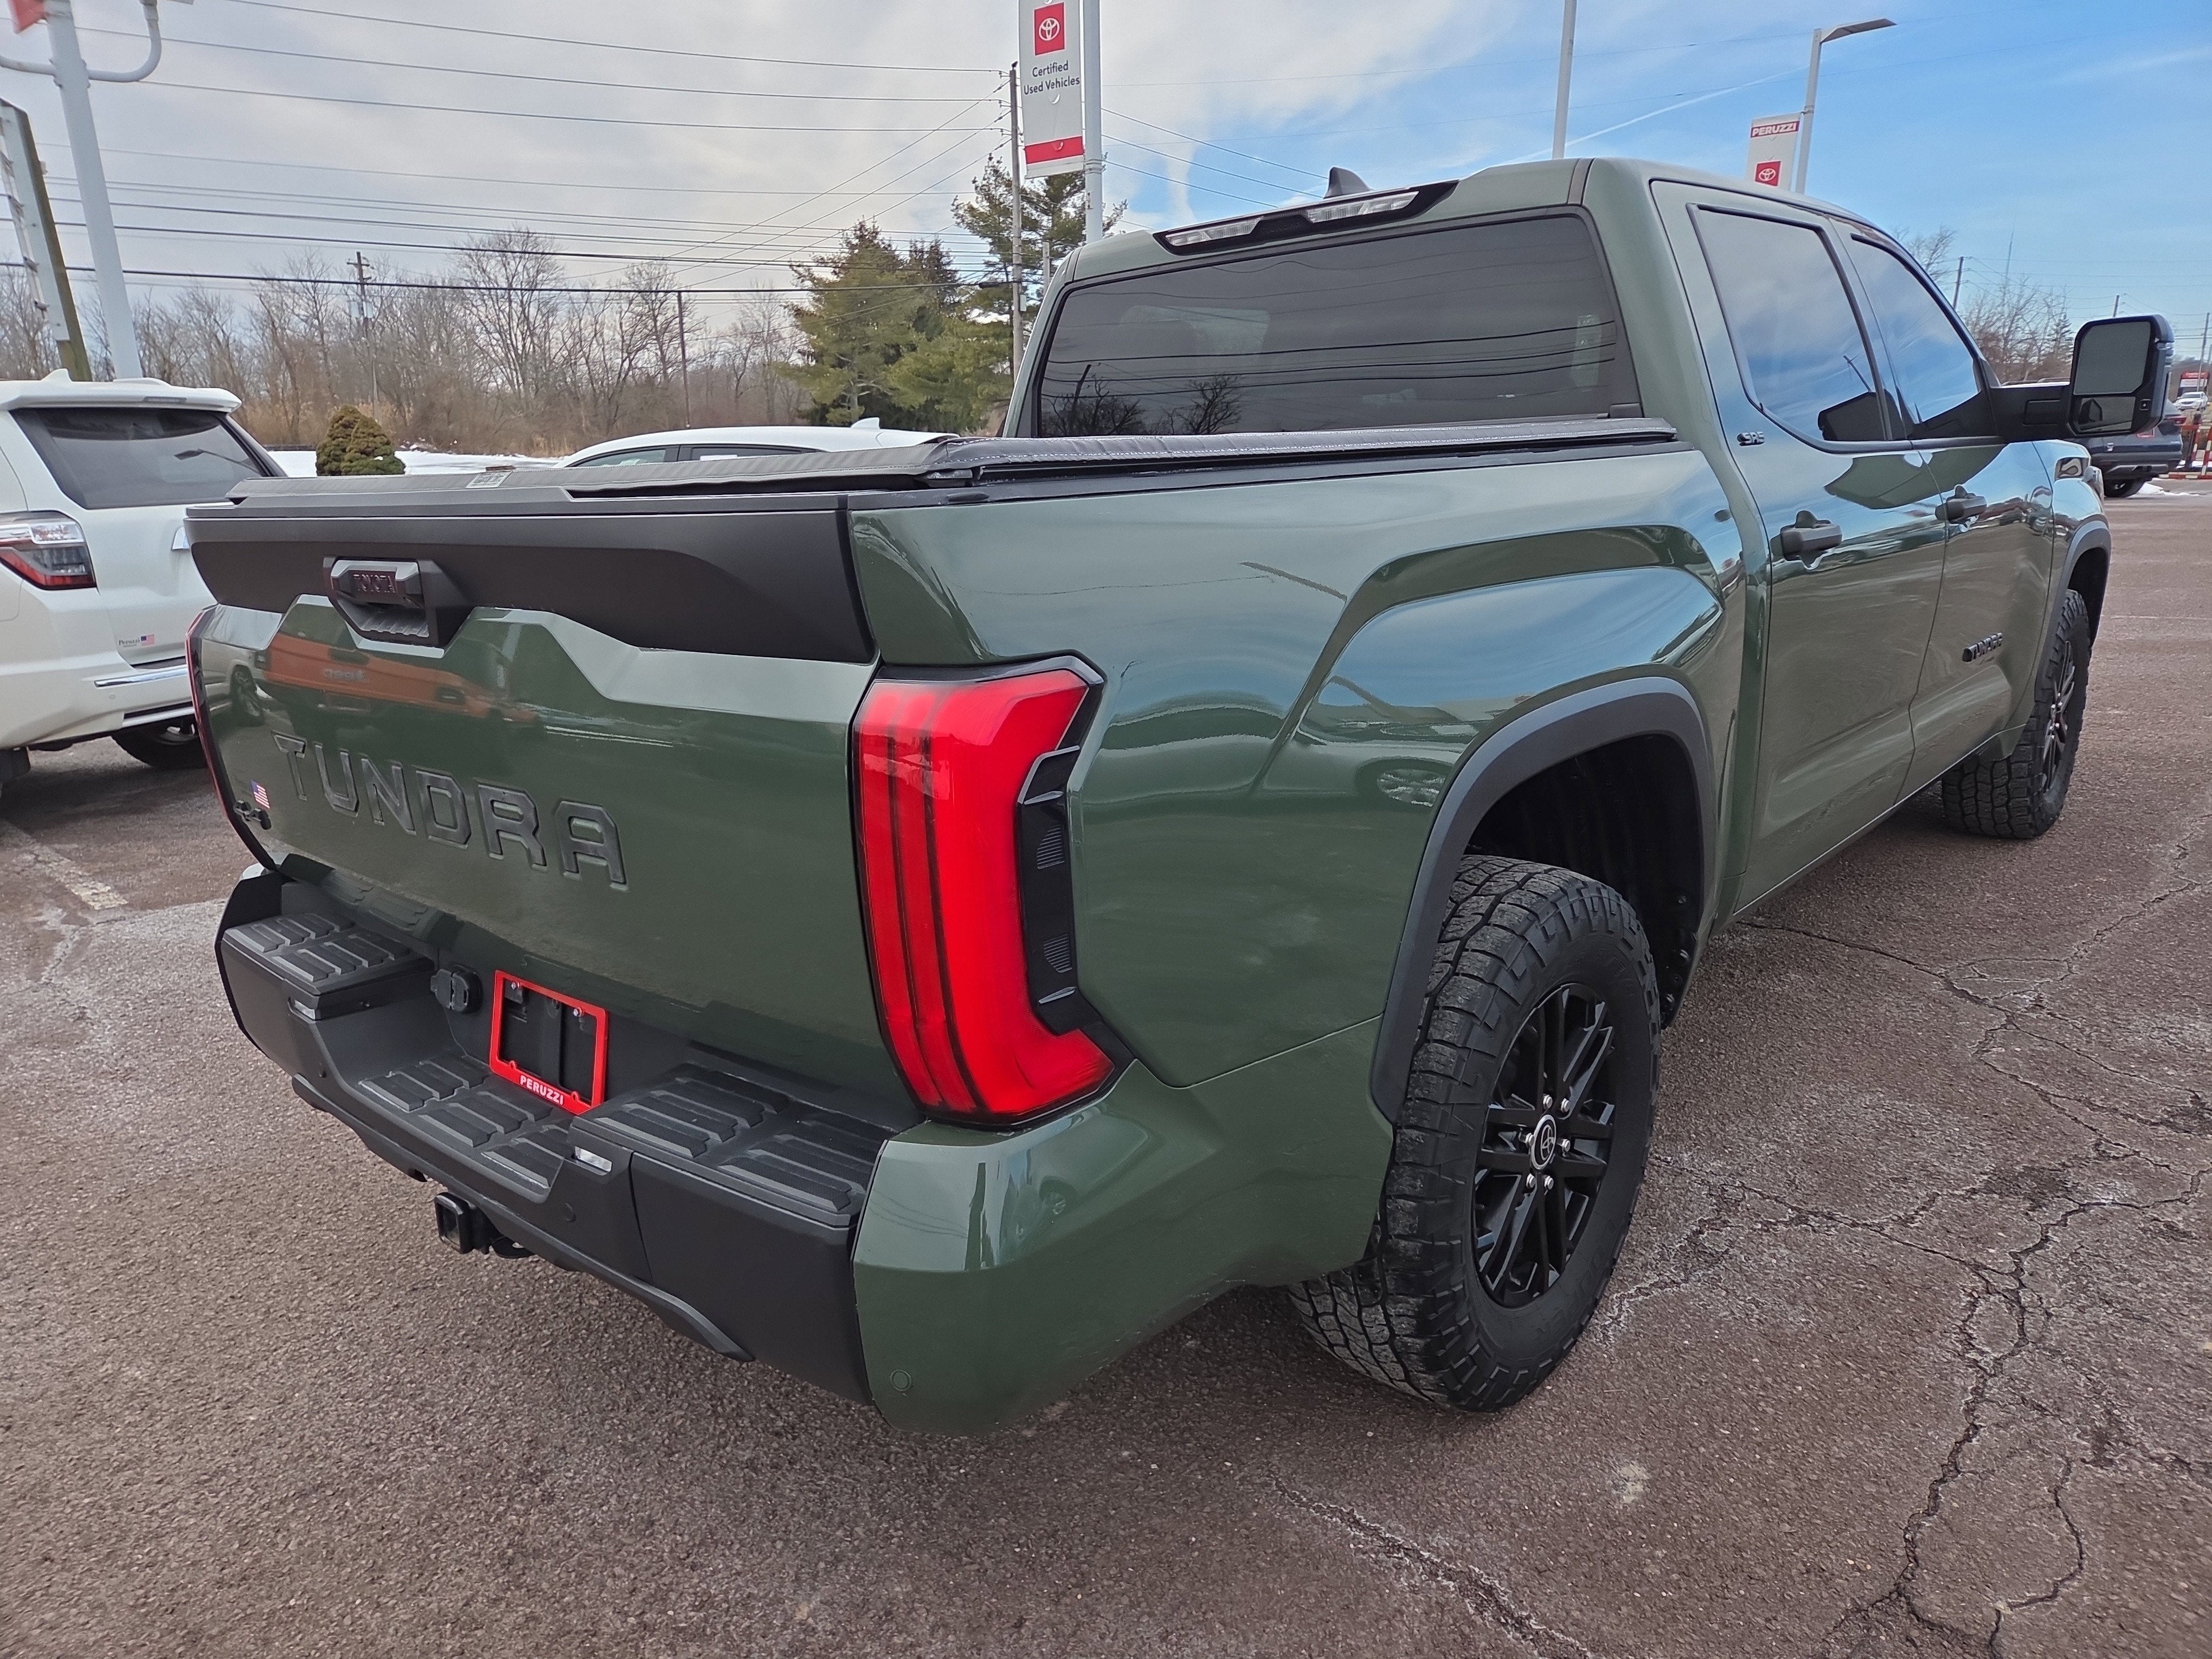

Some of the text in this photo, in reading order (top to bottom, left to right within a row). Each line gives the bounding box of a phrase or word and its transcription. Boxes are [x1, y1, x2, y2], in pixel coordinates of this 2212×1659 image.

[1032, 60, 1069, 78] Certified
[1024, 75, 1080, 95] Used Vehicles
[1752, 122, 1797, 137] PERUZZI
[119, 637, 140, 645] Peruzzi
[272, 730, 629, 892] TUNDRA
[519, 1075, 564, 1106] PERUZZI
